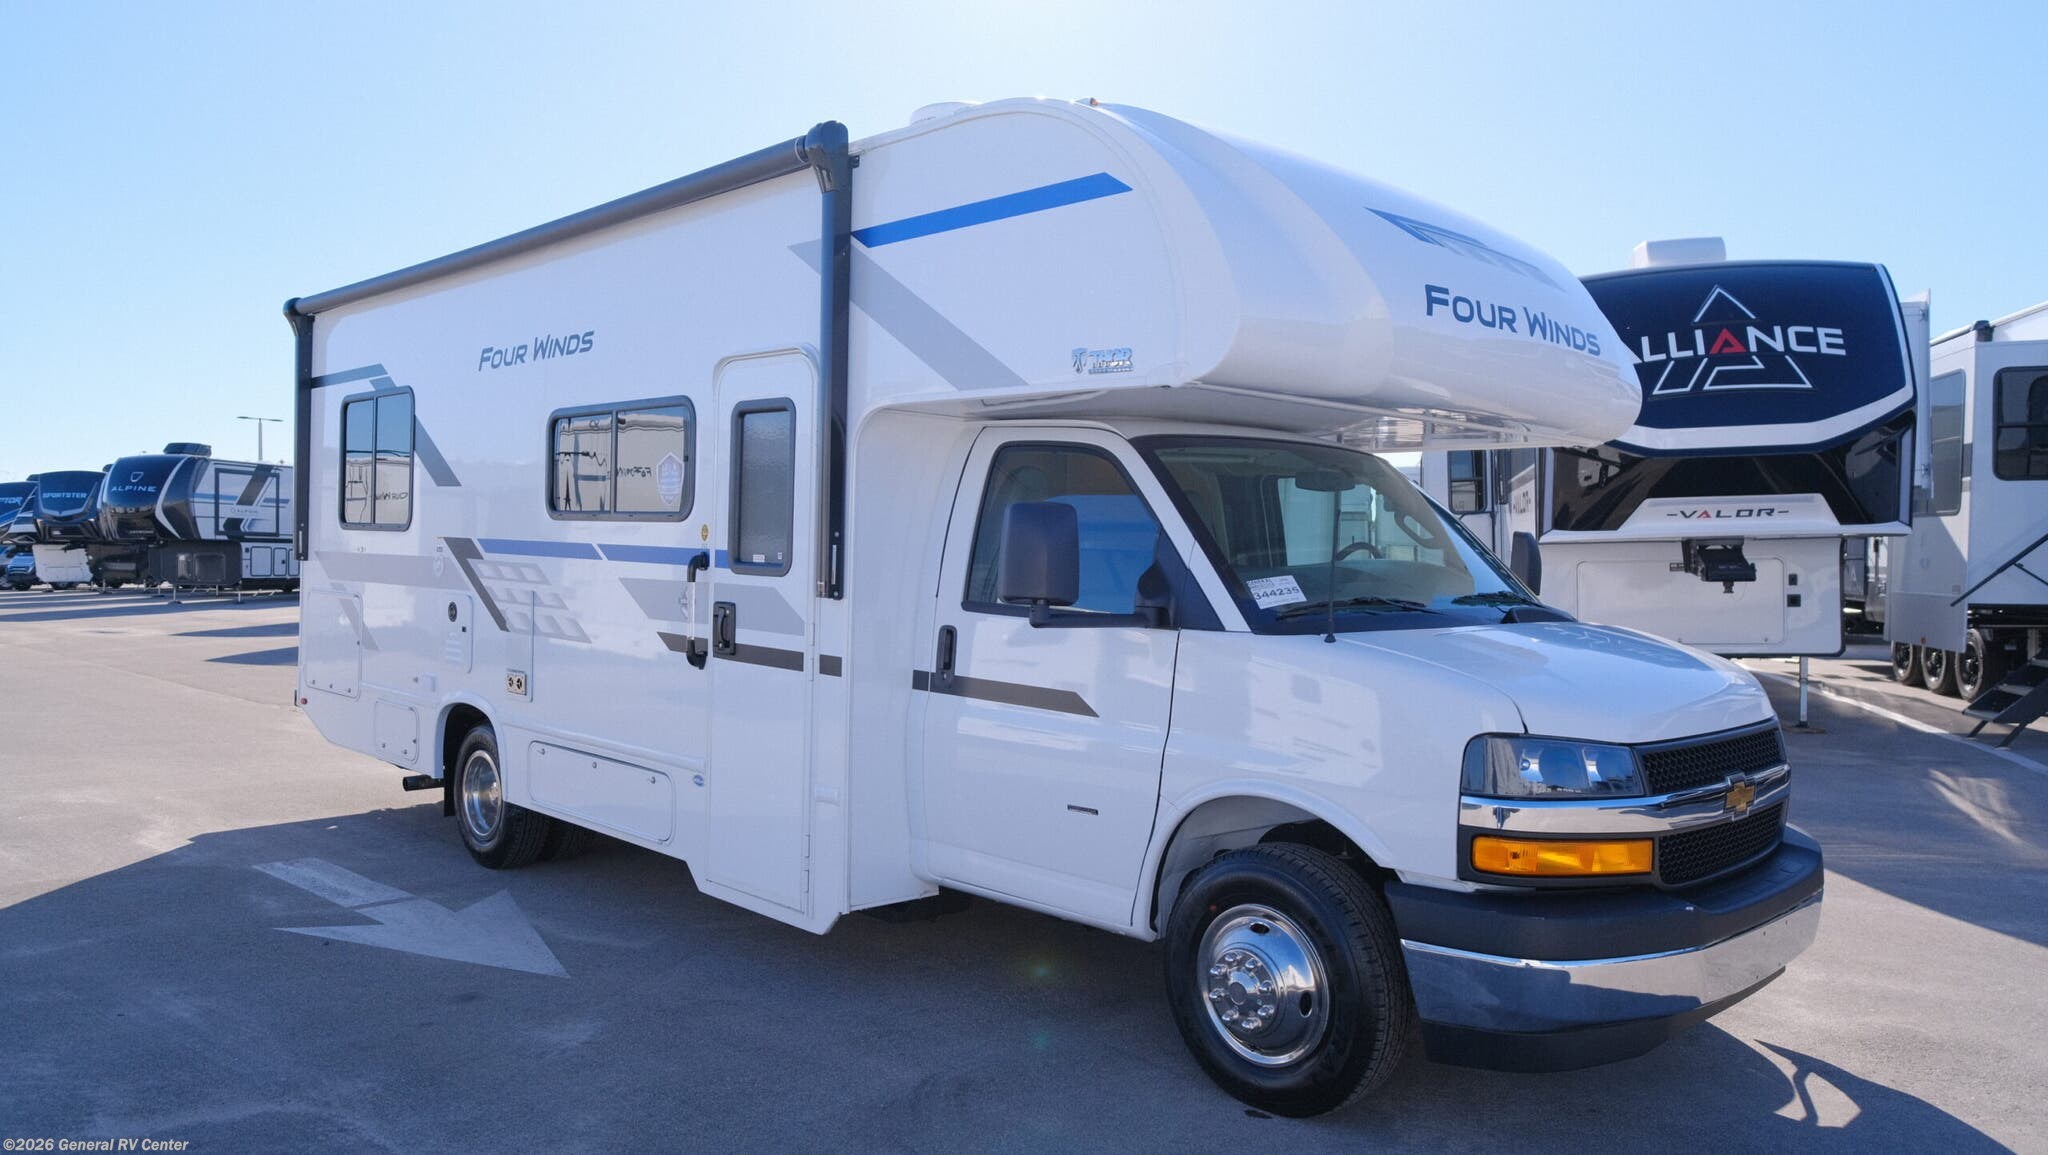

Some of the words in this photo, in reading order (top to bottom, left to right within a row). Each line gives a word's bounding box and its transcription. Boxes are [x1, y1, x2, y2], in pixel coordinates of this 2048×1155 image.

[1424, 284, 1517, 333] FOUR
[1522, 306, 1600, 356] WINDS
[478, 344, 528, 372] FOUR
[533, 330, 595, 361] WINDS
[1633, 324, 1847, 364] LLIANCE
[111, 485, 157, 493] ALPINE
